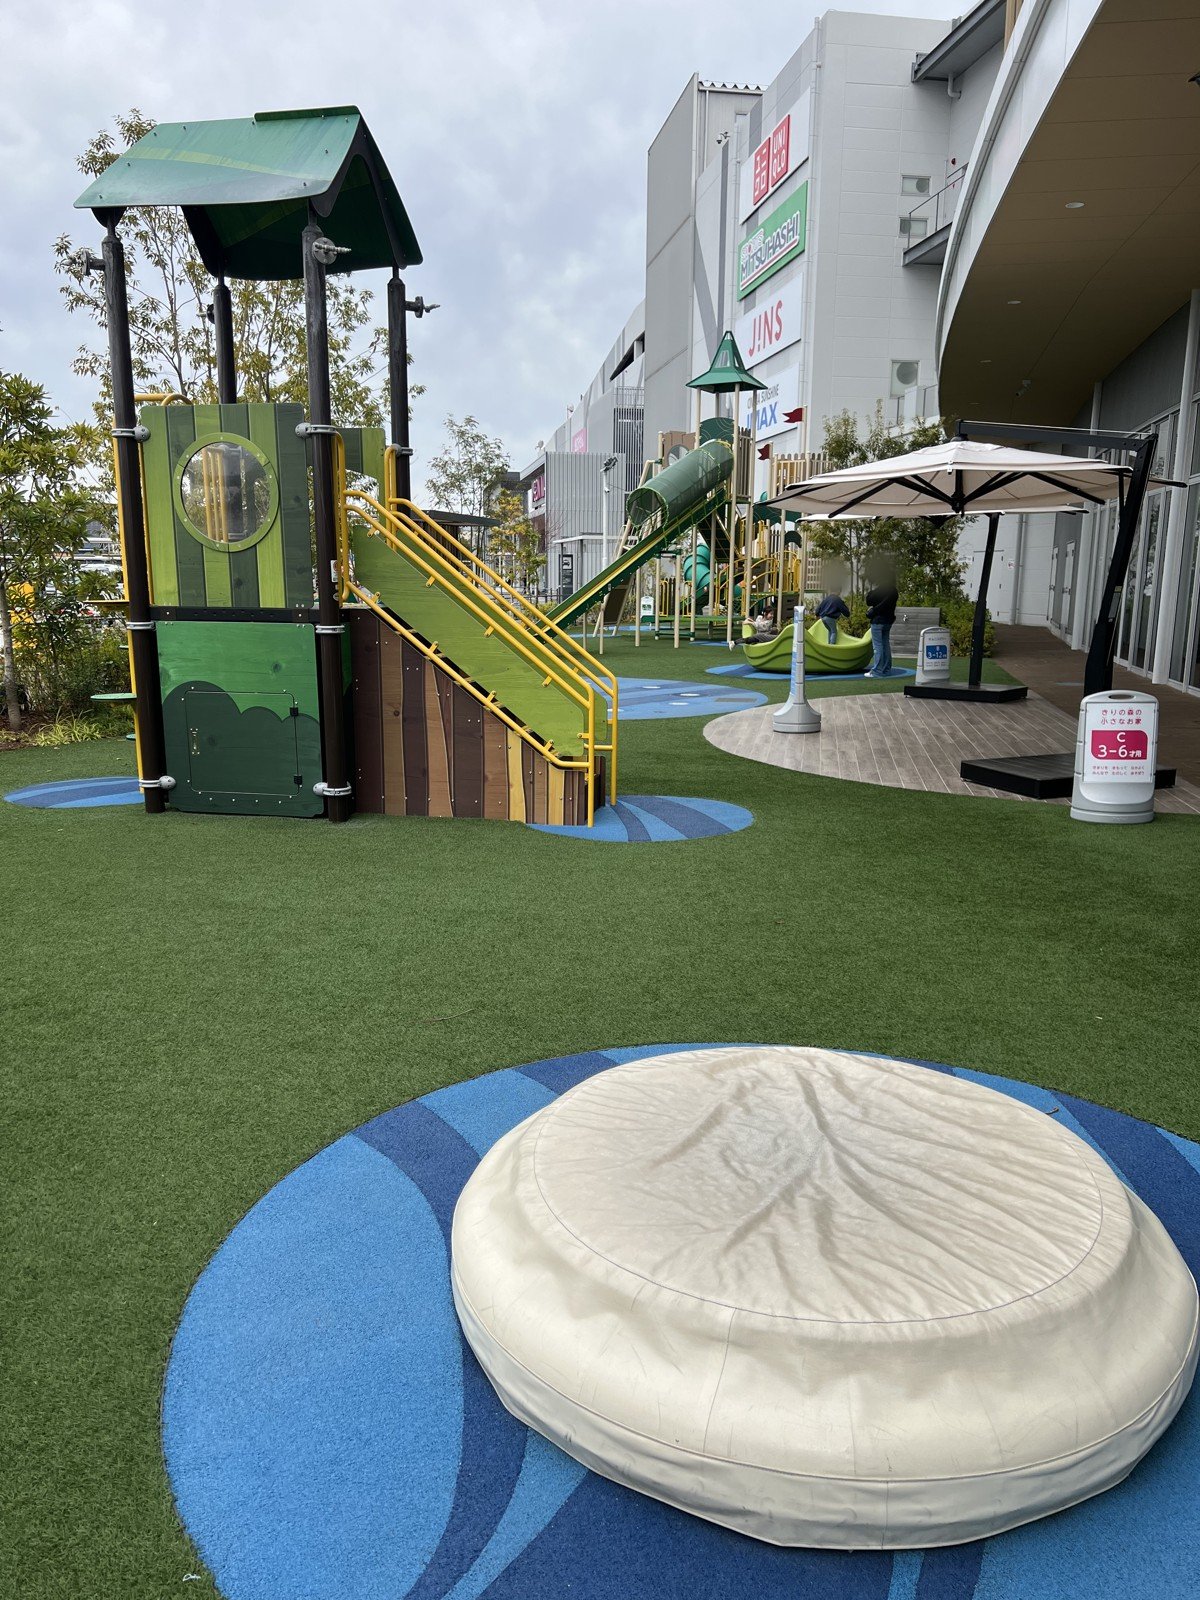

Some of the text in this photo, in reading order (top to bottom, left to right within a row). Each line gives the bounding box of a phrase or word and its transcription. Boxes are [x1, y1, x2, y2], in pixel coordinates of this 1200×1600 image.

[772, 125, 787, 154] UNI
[772, 148, 786, 179] QLO
[741, 211, 800, 282] MITSUHASHI
[1101, 708, 1142, 716] きりの森の
[1101, 717, 1142, 725] 小さなお家
[1117, 732, 1126, 742] C
